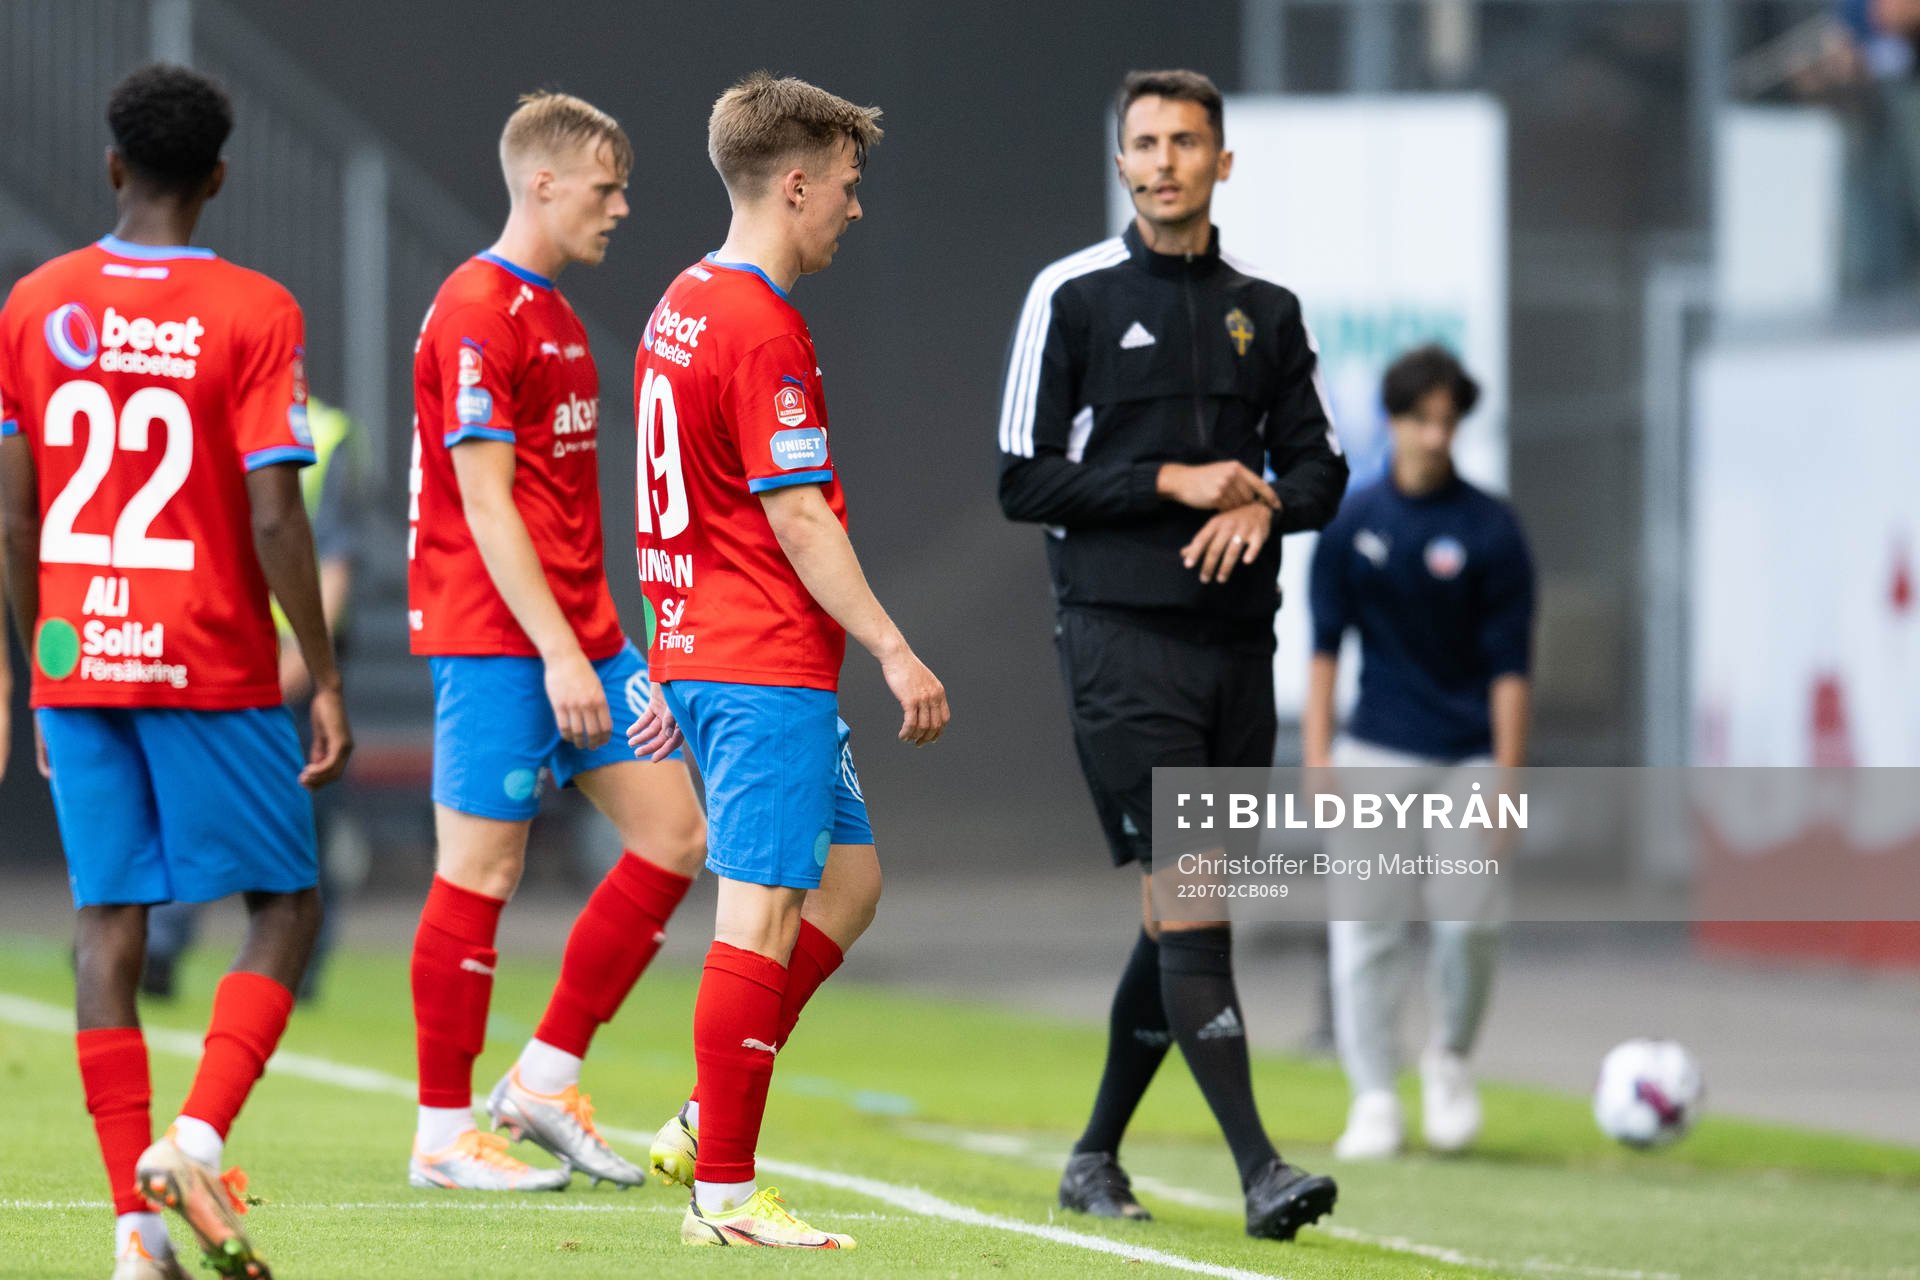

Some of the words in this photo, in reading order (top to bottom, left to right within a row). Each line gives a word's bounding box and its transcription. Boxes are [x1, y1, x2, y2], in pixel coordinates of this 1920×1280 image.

[101, 307, 204, 356] beat
[656, 301, 707, 348] beat
[99, 347, 197, 380] diabetes
[654, 336, 693, 368] dbetes
[636, 367, 689, 540] 19
[775, 437, 821, 453] UNIBET
[39, 379, 195, 571] 22
[82, 575, 130, 618] ALI
[82, 619, 164, 658] Solid
[80, 655, 188, 689] Försäkring
